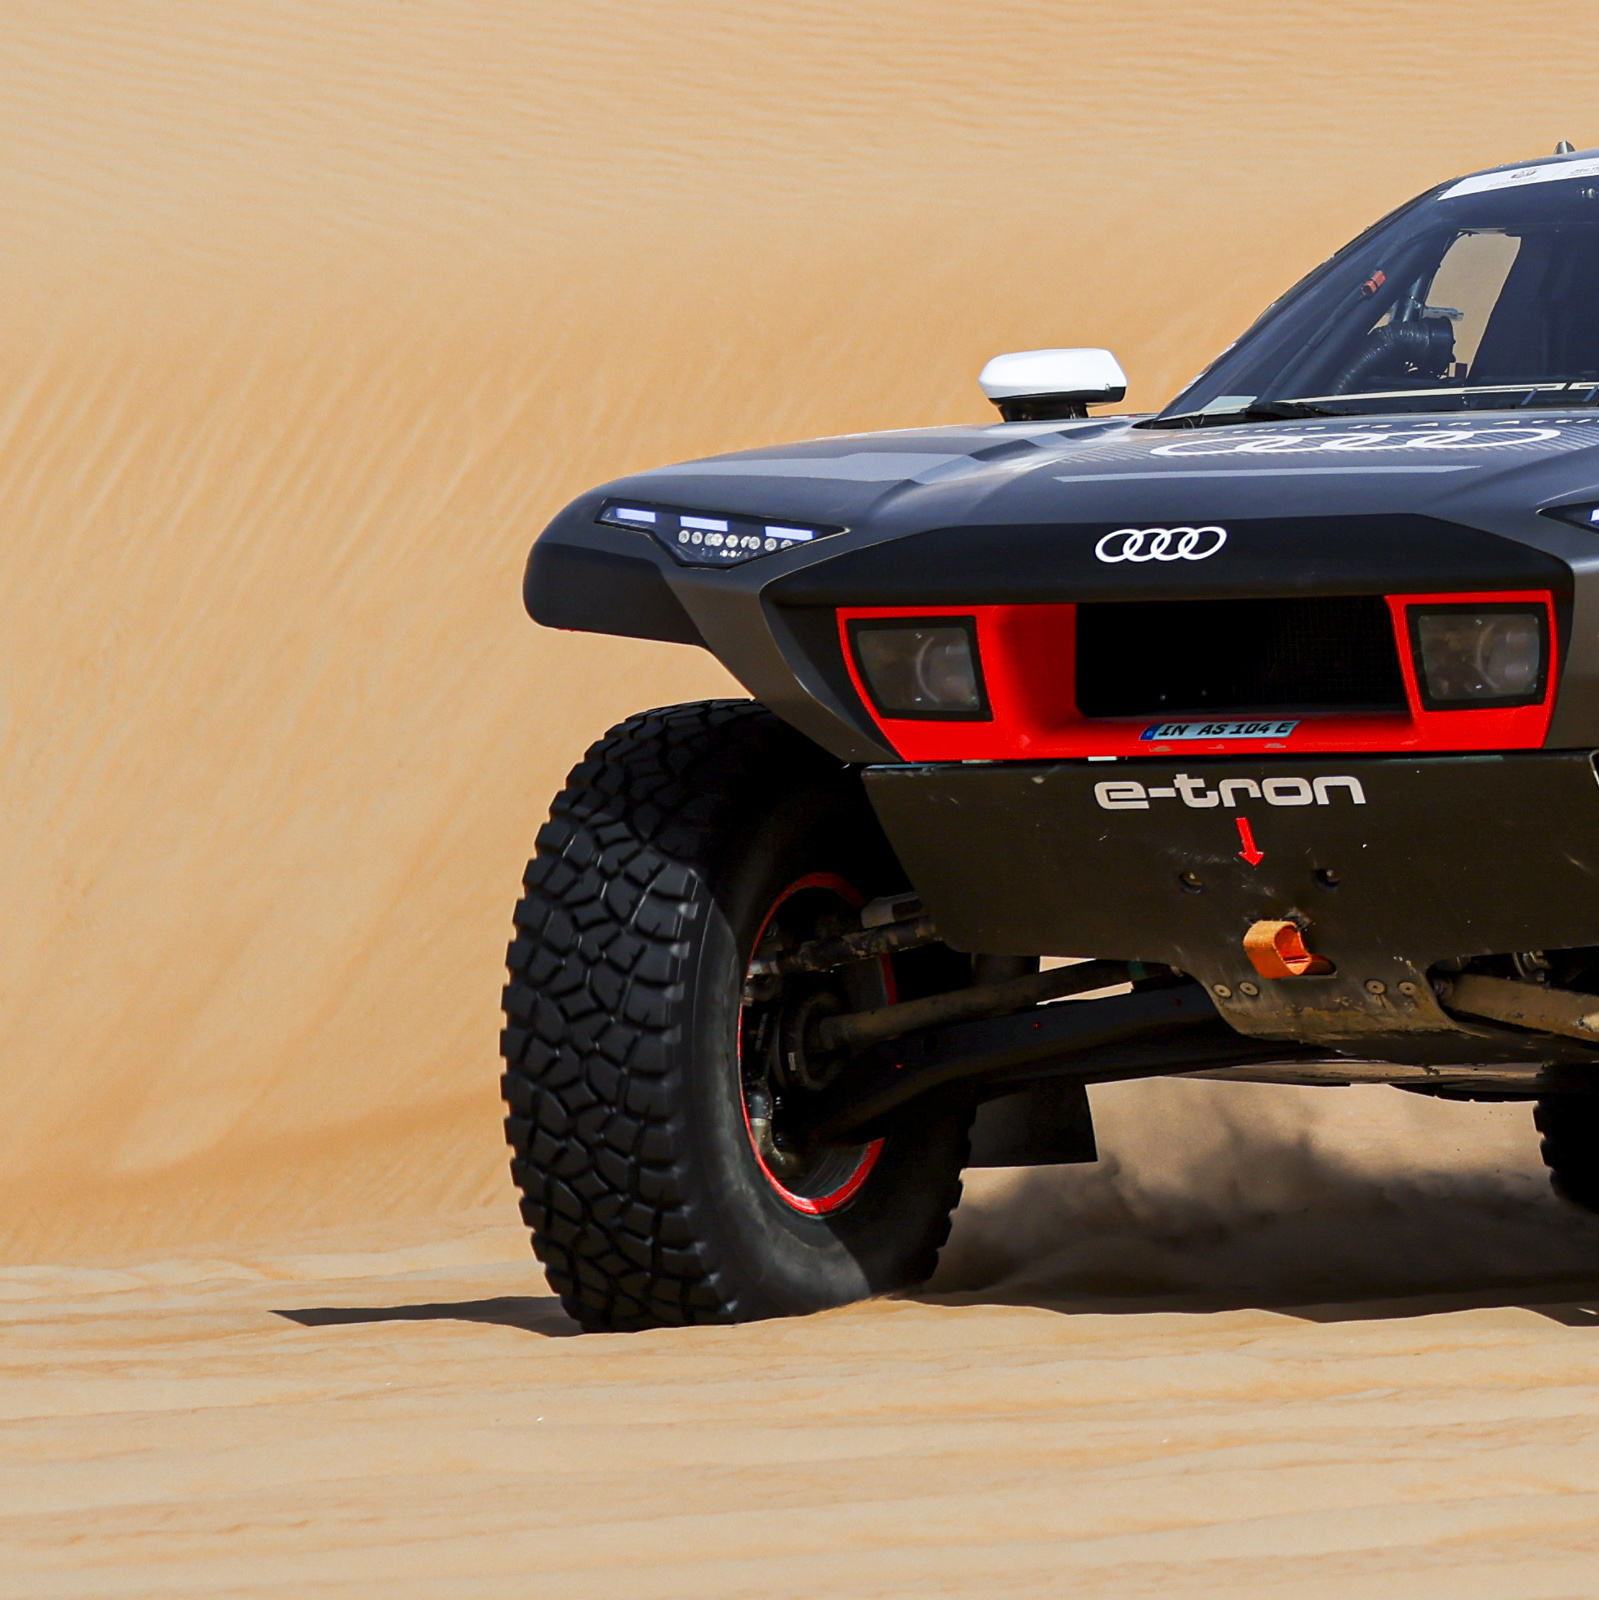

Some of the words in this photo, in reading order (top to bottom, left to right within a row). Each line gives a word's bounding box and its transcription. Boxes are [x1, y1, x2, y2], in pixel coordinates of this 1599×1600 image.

[1158, 724, 1190, 736] IN
[1197, 723, 1229, 736] AS
[1229, 722, 1272, 735] 104
[1275, 721, 1295, 734] E
[1094, 773, 1366, 809] e-tron
